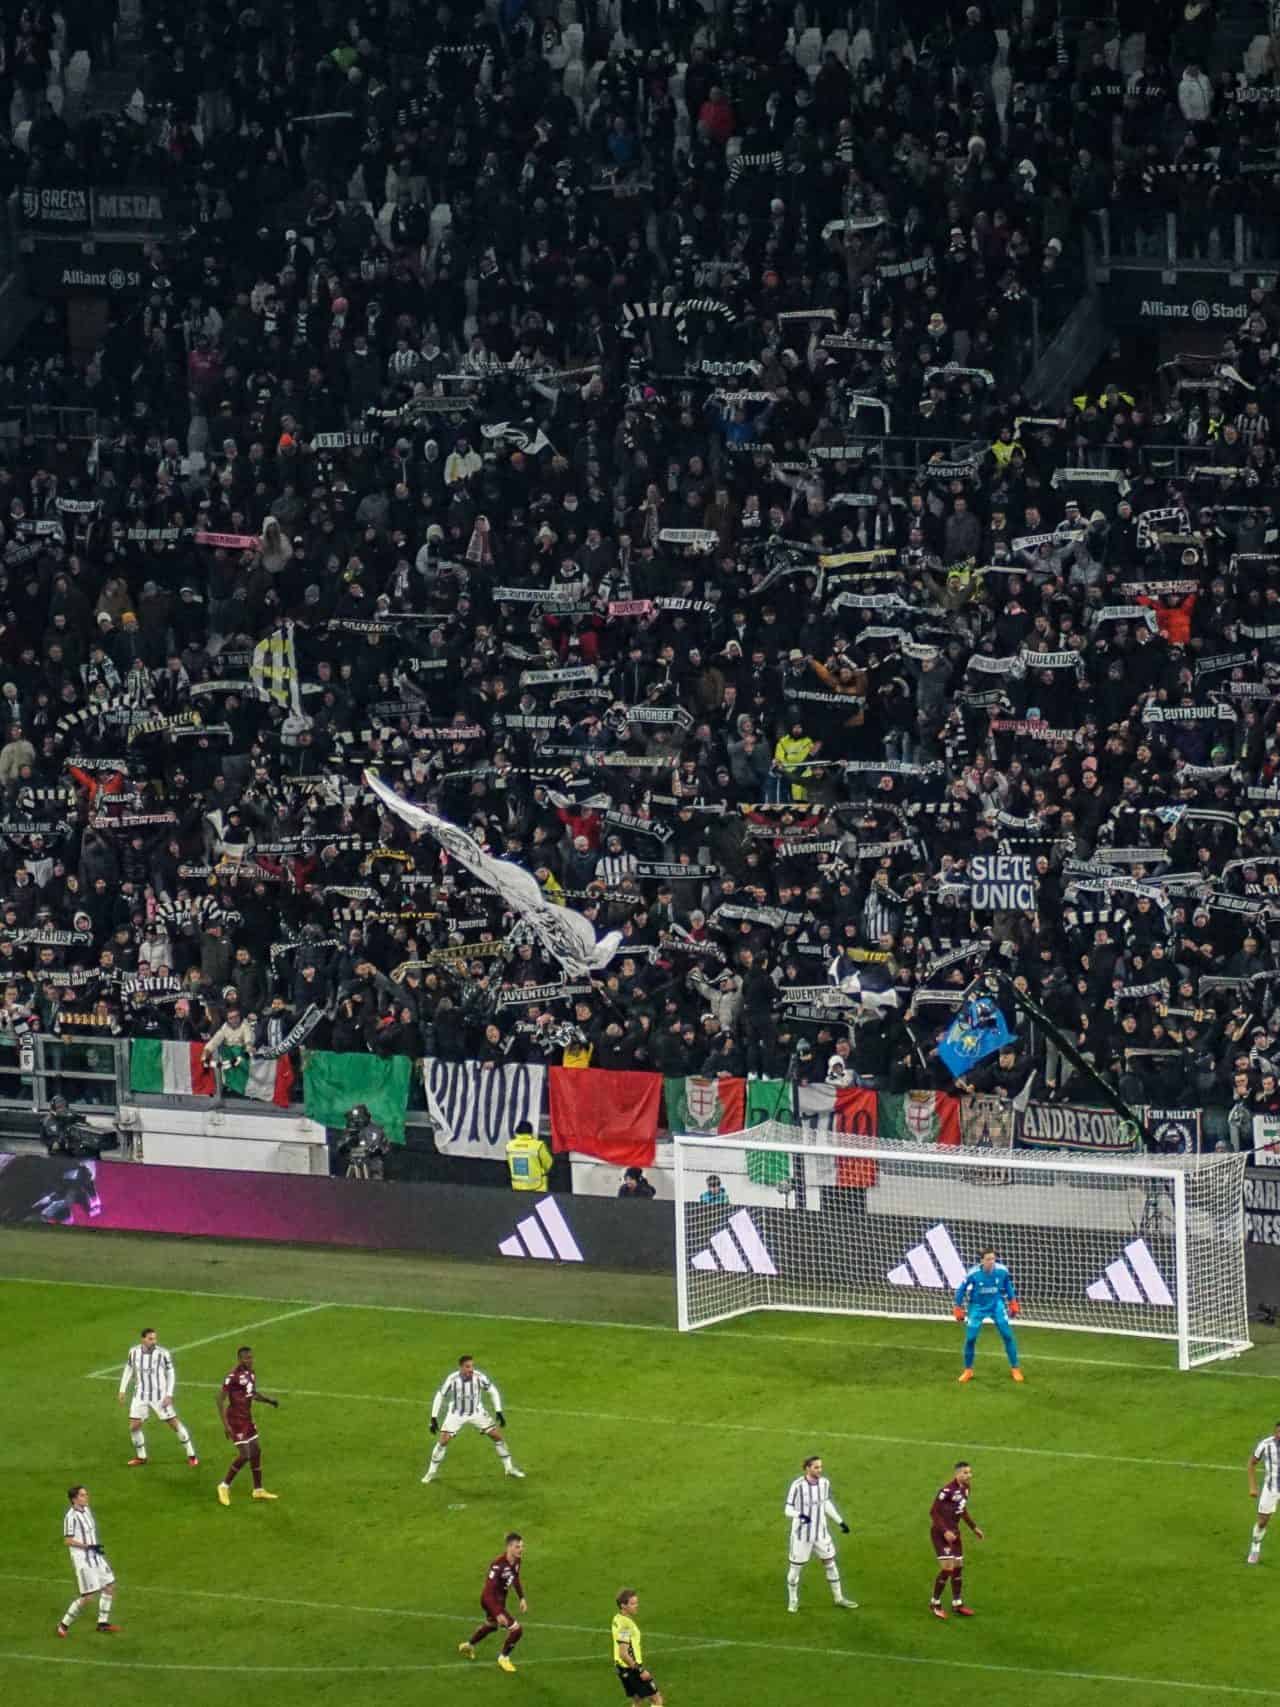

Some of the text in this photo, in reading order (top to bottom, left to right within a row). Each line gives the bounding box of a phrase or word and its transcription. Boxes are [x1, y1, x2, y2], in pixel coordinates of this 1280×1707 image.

[62, 269, 106, 286] Allianz
[1139, 300, 1189, 318] Allianz
[1023, 651, 1074, 667] JUVENTUS
[971, 857, 1030, 881] SIETE
[971, 884, 1034, 911] UNICI
[501, 984, 555, 1001] JUVENTUS
